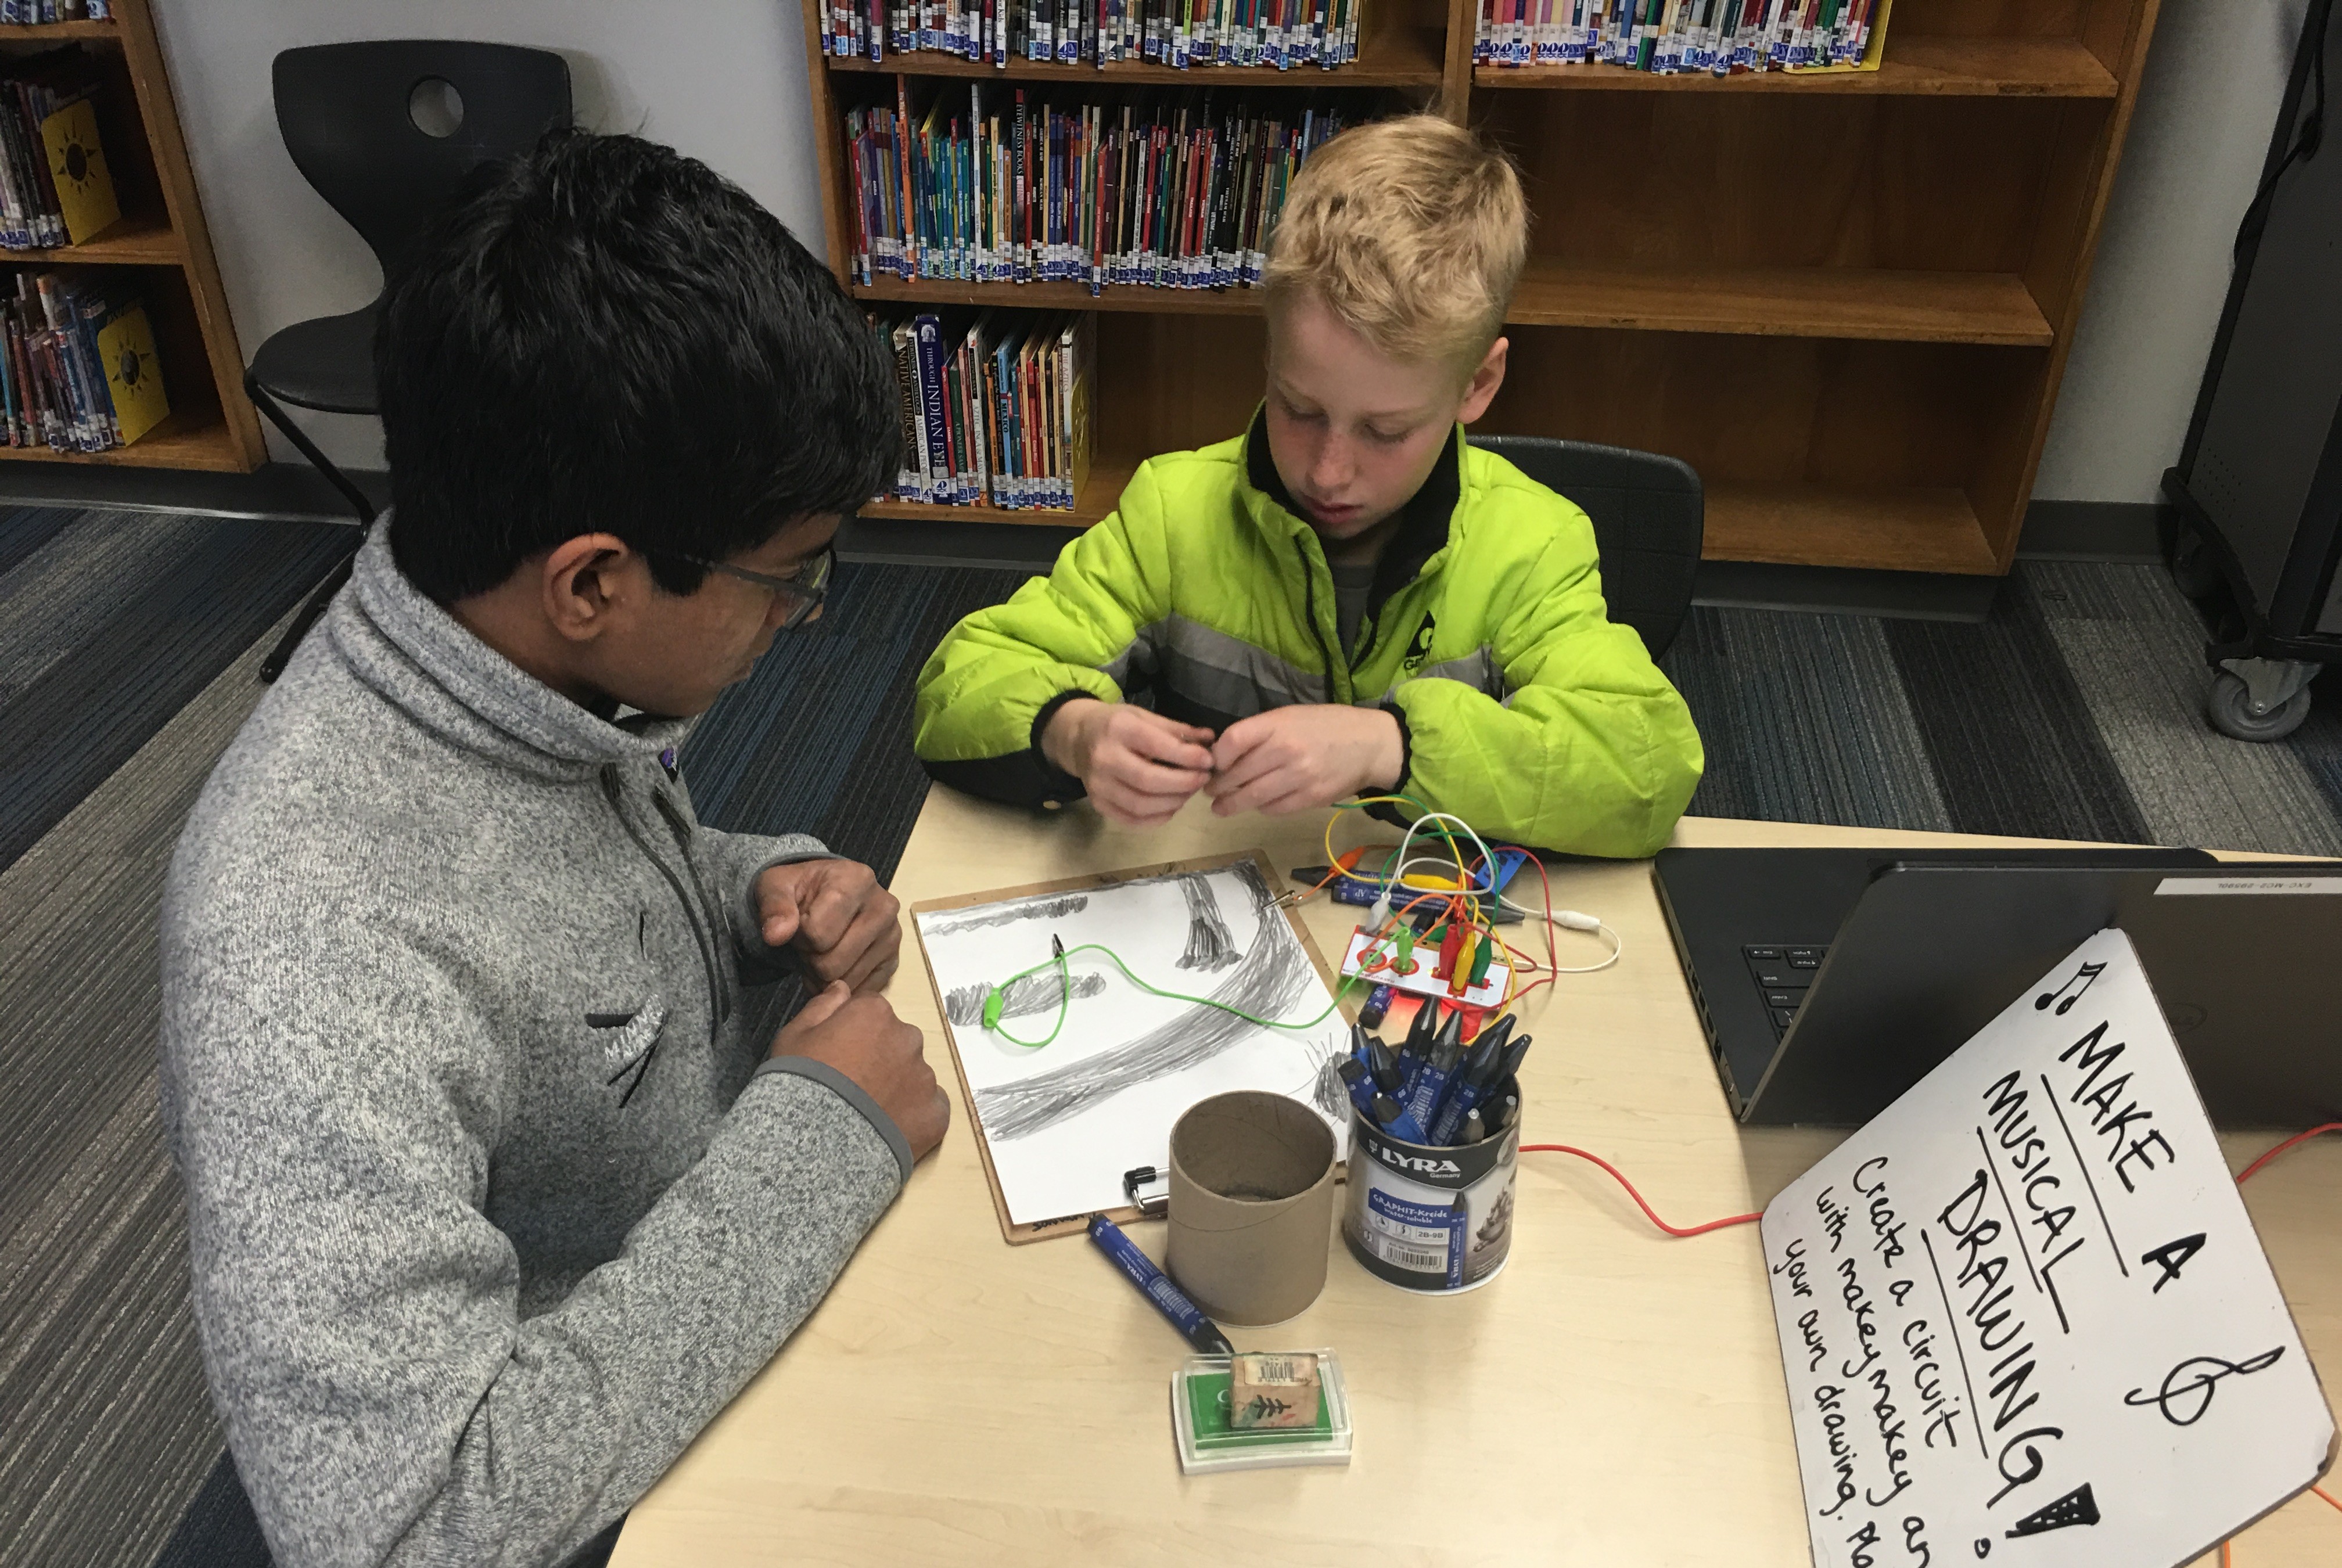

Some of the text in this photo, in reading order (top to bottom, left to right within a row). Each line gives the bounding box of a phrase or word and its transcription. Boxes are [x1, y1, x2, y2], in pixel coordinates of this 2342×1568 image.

[926, 347, 935, 383] THROUGH
[898, 350, 916, 449] NATIVE AMERICANS
[927, 384, 943, 437] INDIAN
[1001, 402, 1009, 433] MEXICO
[916, 417, 925, 454] AMERICAN
[956, 429, 964, 454] PIONEER
[1382, 1147, 1461, 1173] LYRA
[2059, 1020, 2207, 1294] MAKE A
[1373, 1193, 1447, 1218] GRAPHIT-Kreide
[1816, 1186, 1849, 1253] with
[1983, 1070, 2085, 1334] MUSICAL
[1773, 1238, 1813, 1297] your
[1798, 1310, 1827, 1372] own
[1853, 1157, 1961, 1448] Create a circuit
